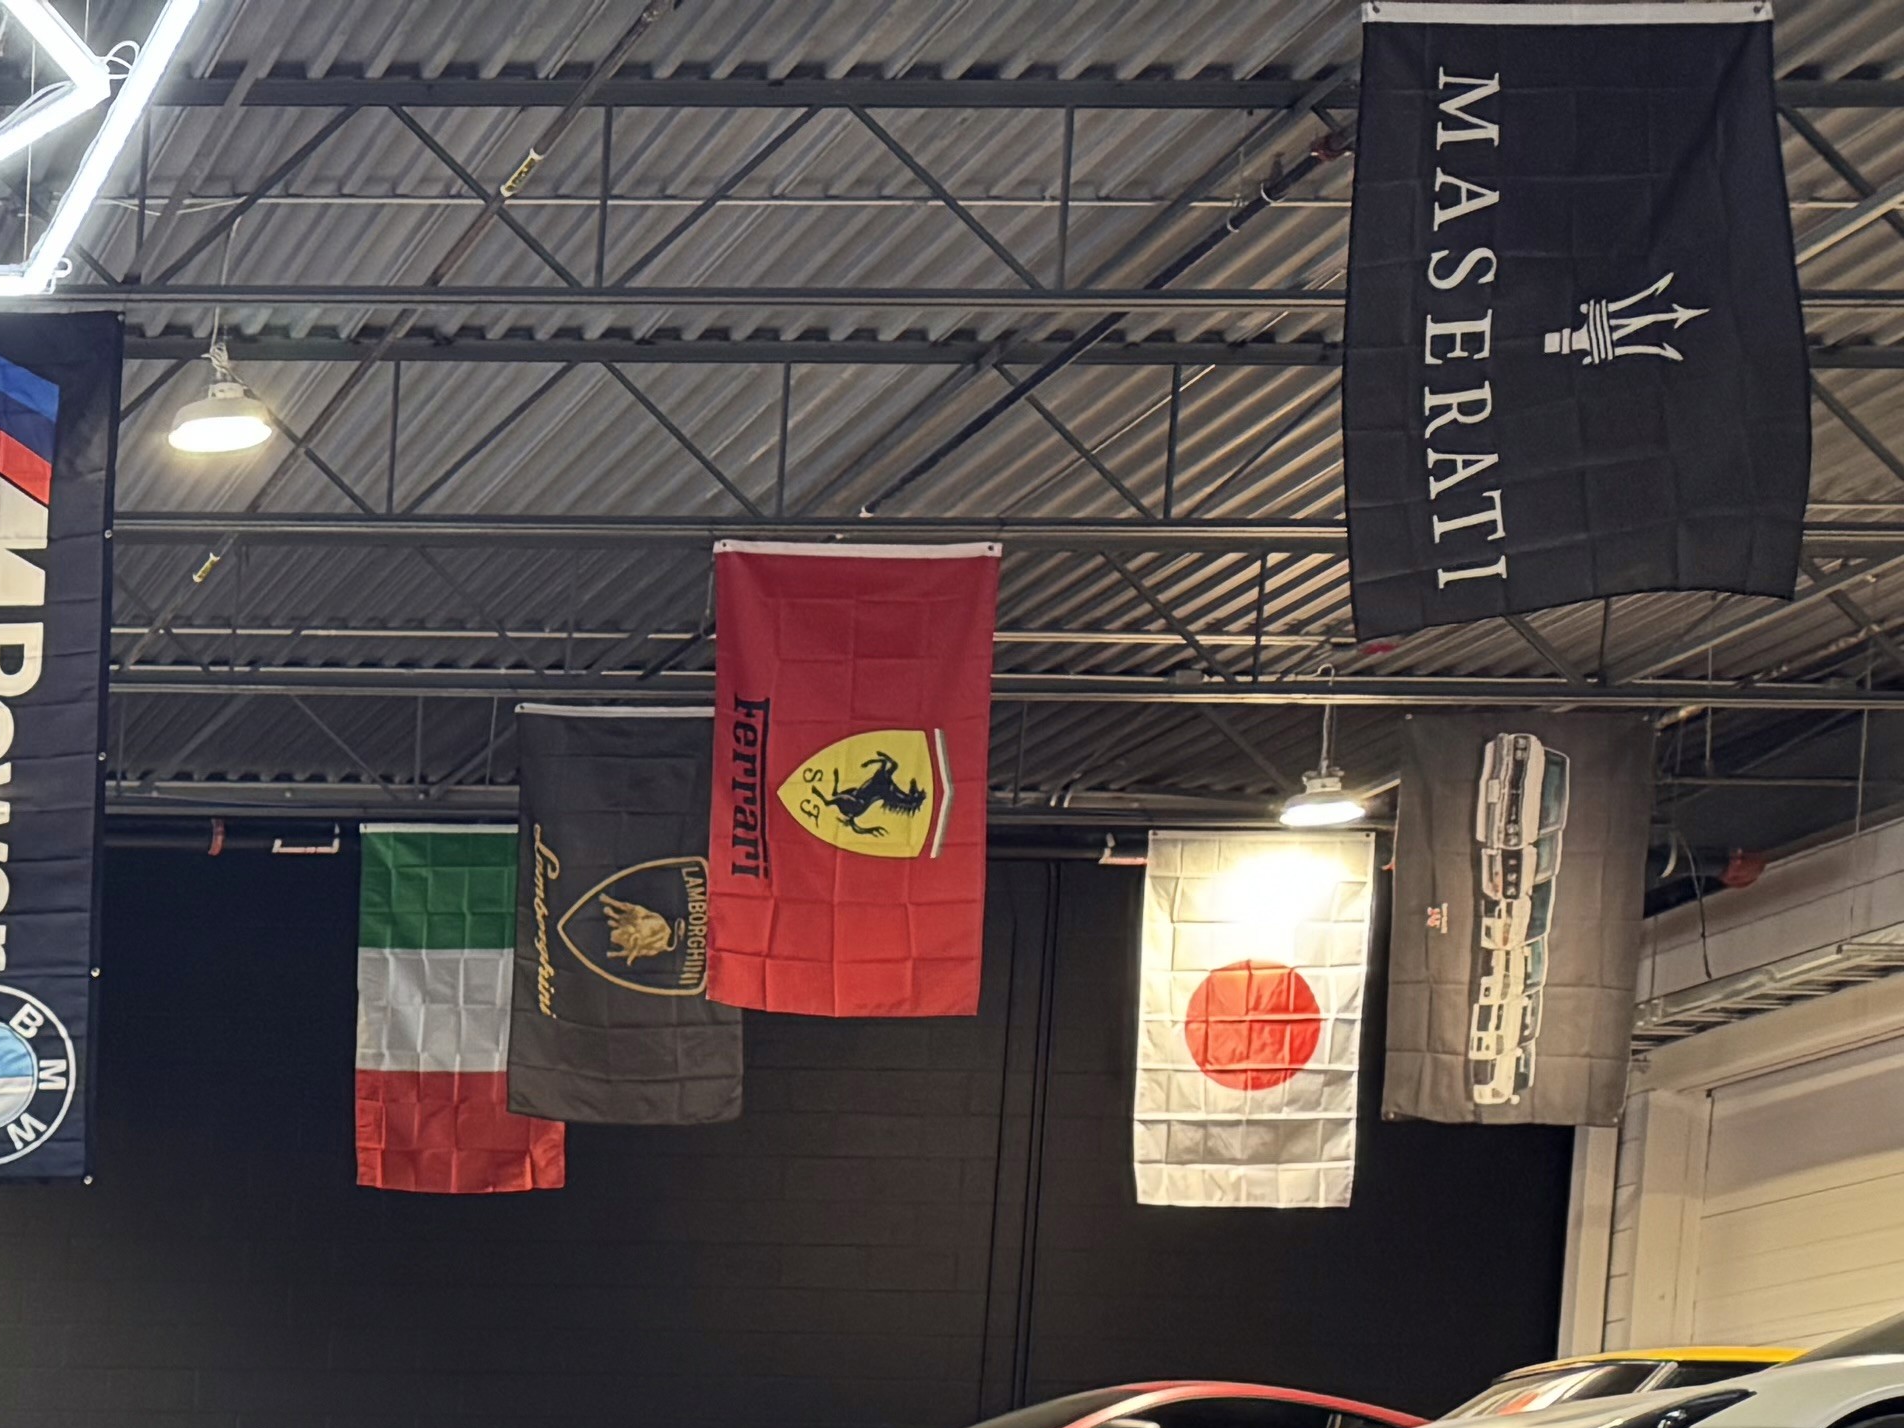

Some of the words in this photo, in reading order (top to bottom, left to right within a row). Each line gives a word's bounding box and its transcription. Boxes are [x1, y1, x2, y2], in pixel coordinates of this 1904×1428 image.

[1423, 66, 1508, 590] MASERATI
[731, 692, 771, 880] Ferrari
[678, 866, 707, 986] LAMBORGHINI
[6, 1002, 68, 1151] BMW
